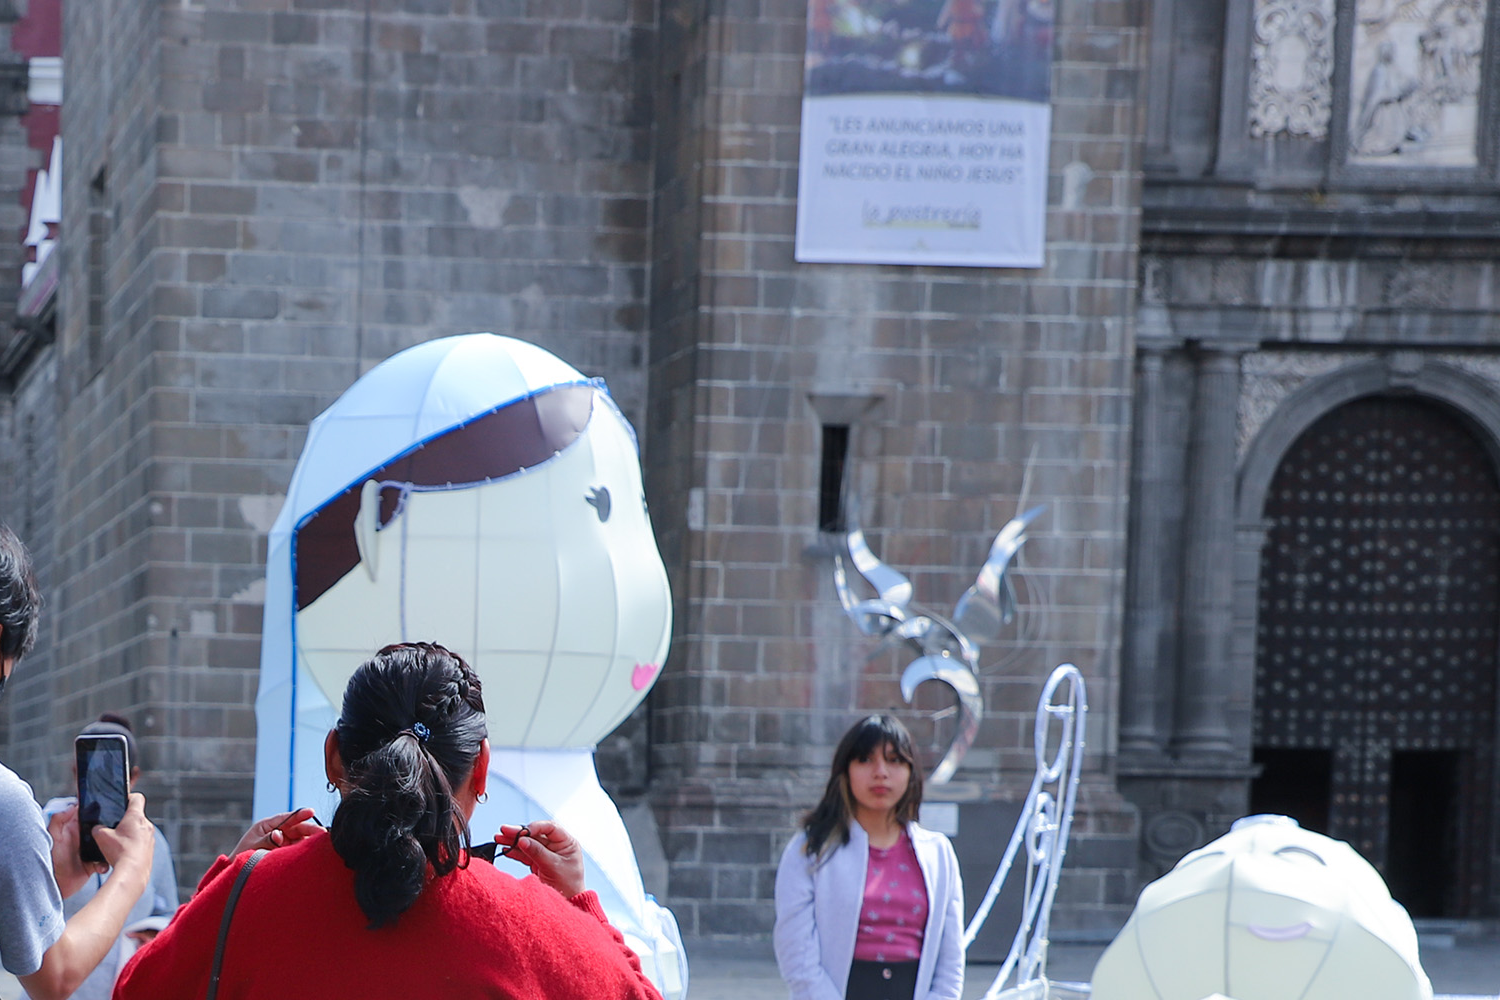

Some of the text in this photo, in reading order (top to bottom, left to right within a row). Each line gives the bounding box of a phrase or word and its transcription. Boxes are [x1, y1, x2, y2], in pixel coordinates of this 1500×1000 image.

[866, 117, 984, 137] ANUNCIAMOS
[987, 120, 1025, 138] UNA
[825, 138, 875, 158] GRAN
[957, 142, 995, 161] HOY
[998, 143, 1025, 161] HA
[822, 161, 891, 181] NACIDO
[893, 163, 912, 183] EL
[916, 163, 963, 183] NIÑO
